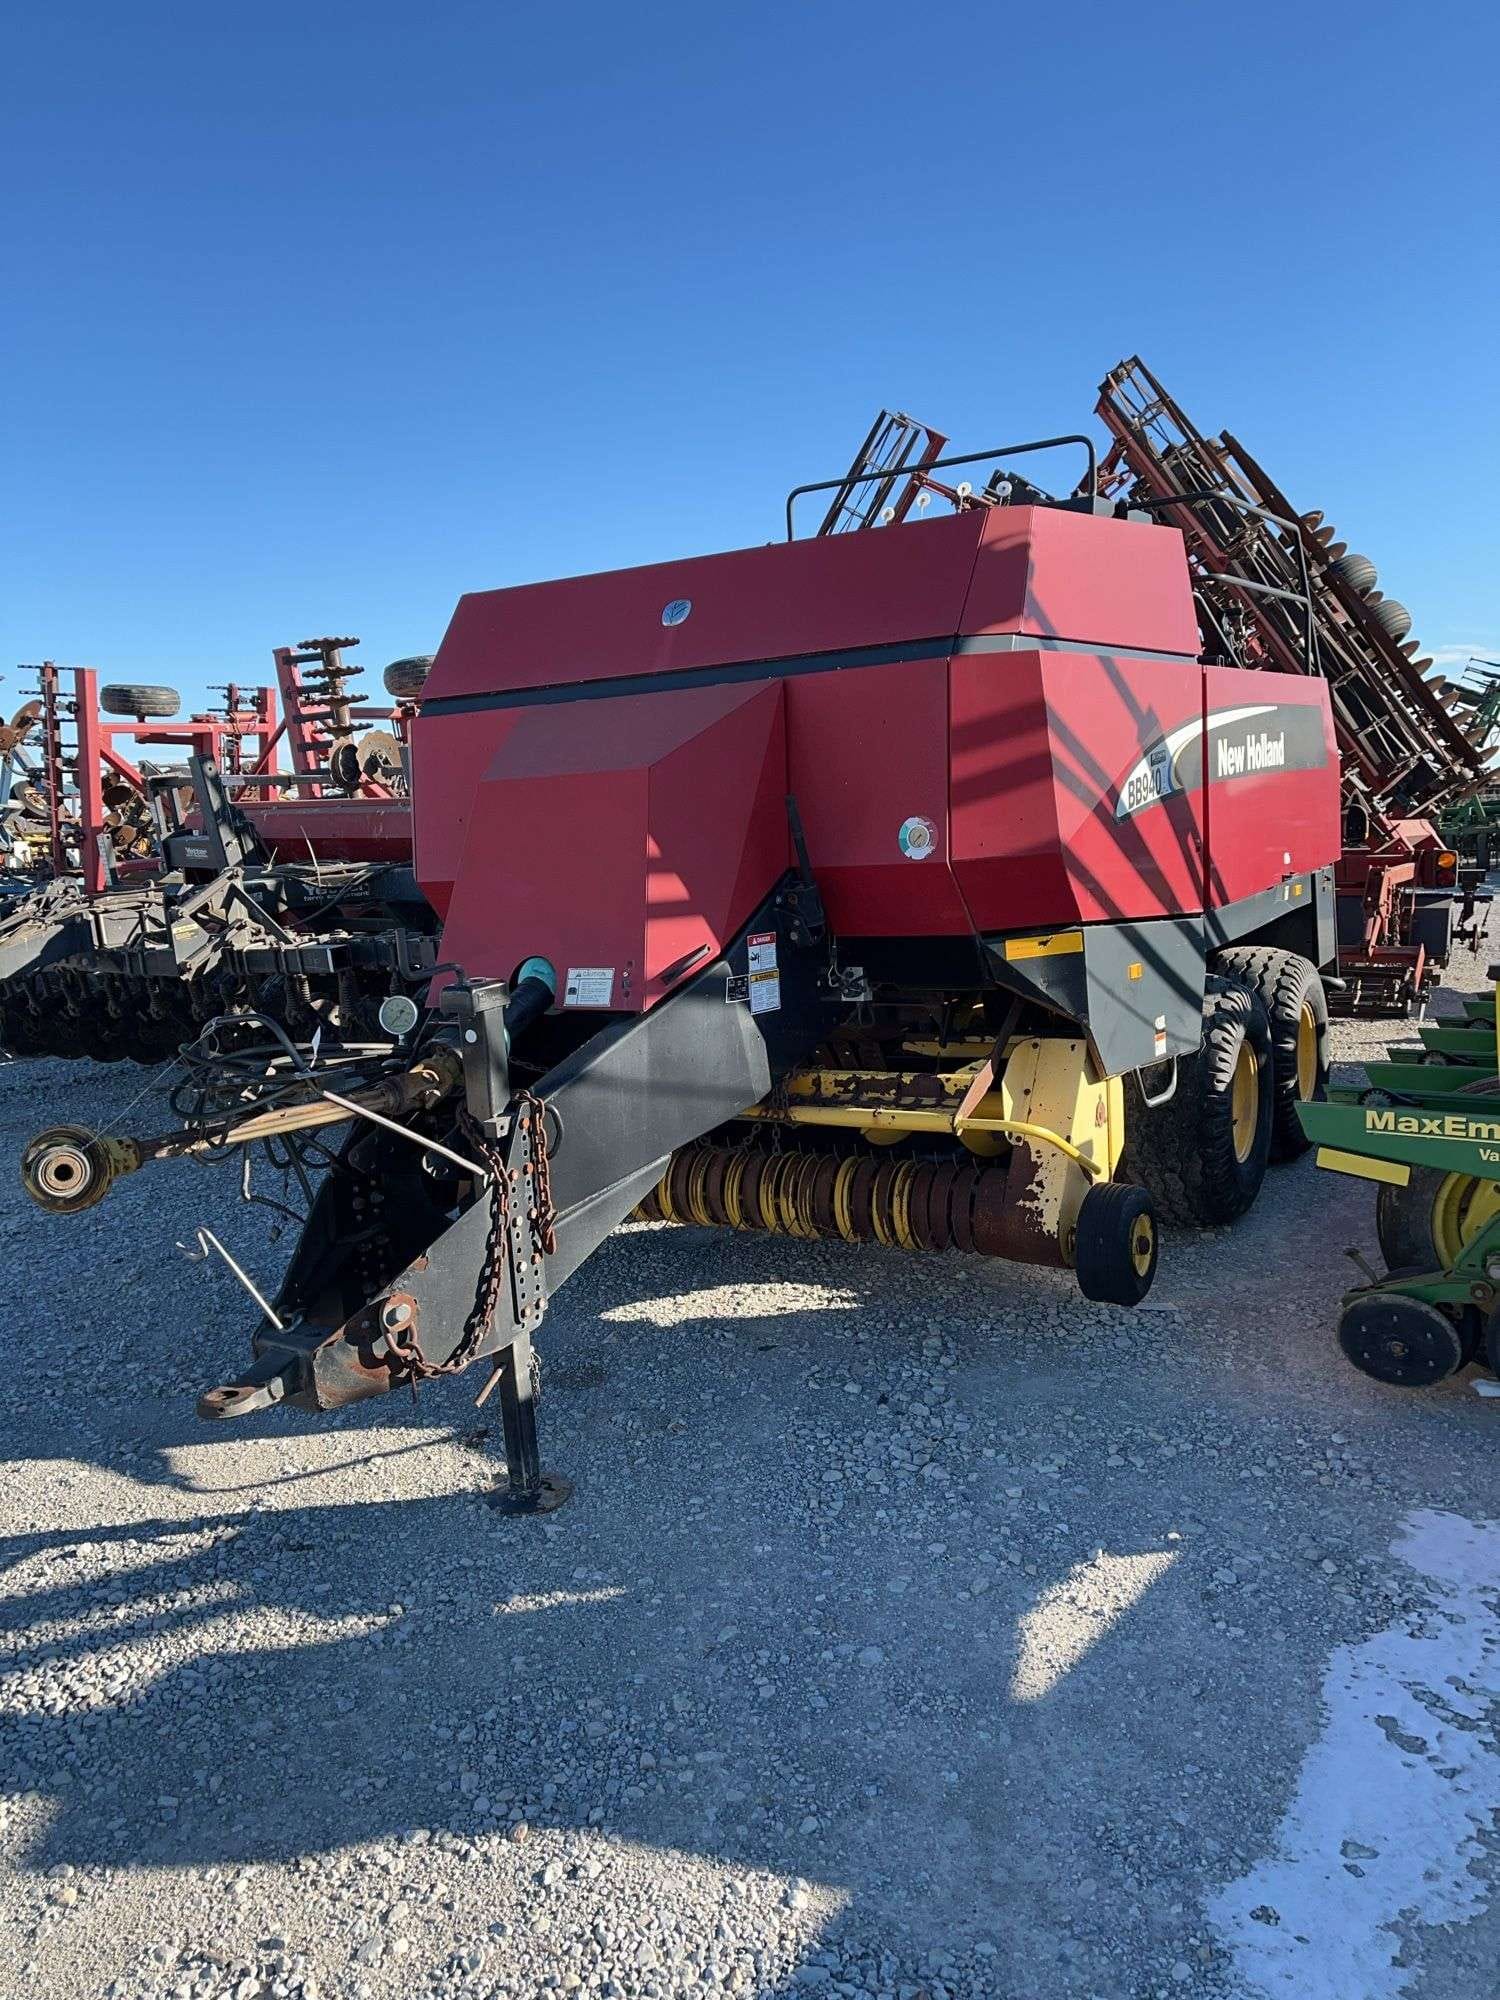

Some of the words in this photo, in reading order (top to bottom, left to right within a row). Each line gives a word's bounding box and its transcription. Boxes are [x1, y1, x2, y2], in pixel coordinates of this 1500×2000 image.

[1217, 738, 1245, 777] New
[1246, 731, 1285, 770] Holland
[1128, 767, 1162, 809] BB940
[1366, 1109, 1500, 1139] MaxEm
[1479, 1148, 1500, 1162] Va
